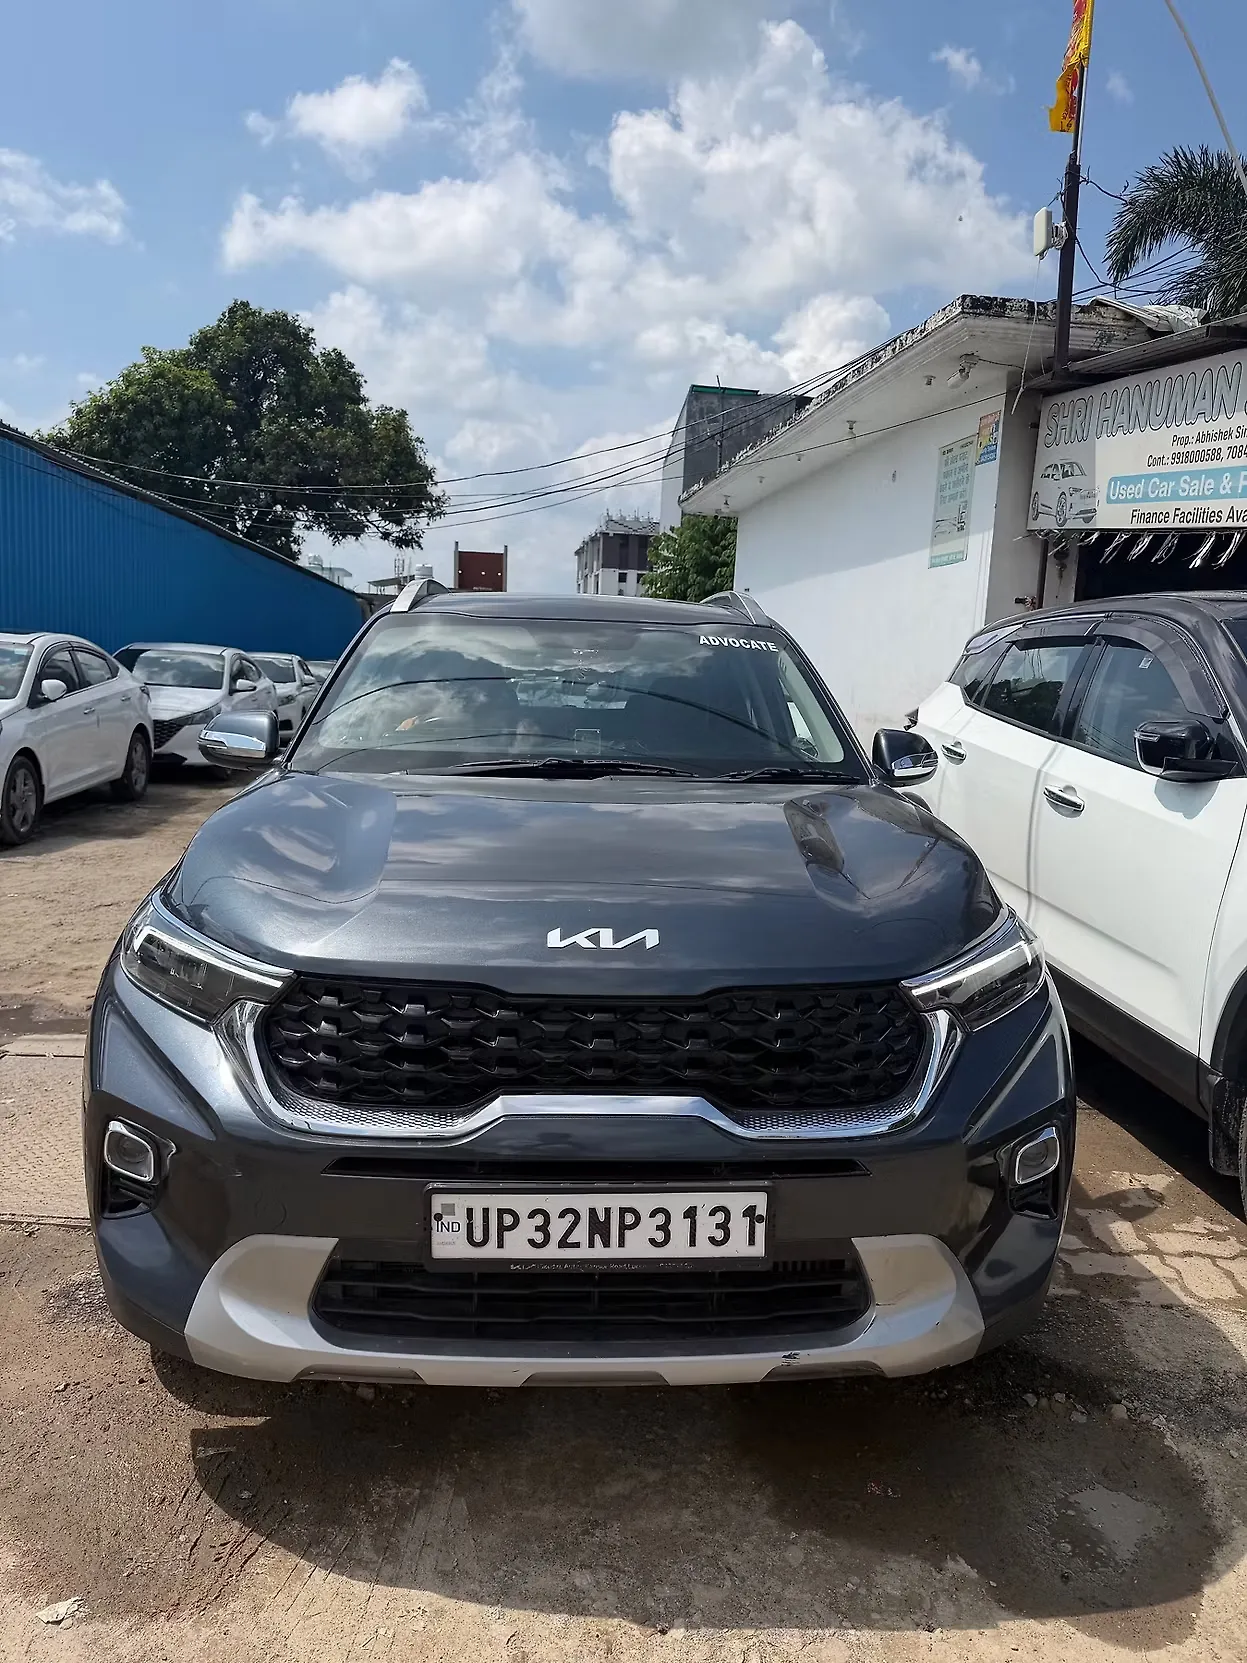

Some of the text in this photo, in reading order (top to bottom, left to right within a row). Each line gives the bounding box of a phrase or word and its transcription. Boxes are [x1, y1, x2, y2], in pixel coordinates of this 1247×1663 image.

[1044, 394, 1094, 448] SHRI
[1096, 361, 1243, 440] HANUMAN
[1195, 427, 1233, 444] Abhishek
[1170, 447, 1224, 465] 9918000588,
[1110, 479, 1143, 500] Used
[1148, 477, 1175, 498] Car
[1178, 474, 1214, 497] Sale
[1220, 472, 1232, 495] &
[1130, 508, 1169, 525] Finance
[1173, 506, 1223, 524] Facilities
[699, 635, 779, 652] ADVOCATE
[547, 928, 660, 951] KIA
[436, 1221, 461, 1233] IND
[466, 1204, 759, 1250] UP32NP3131
